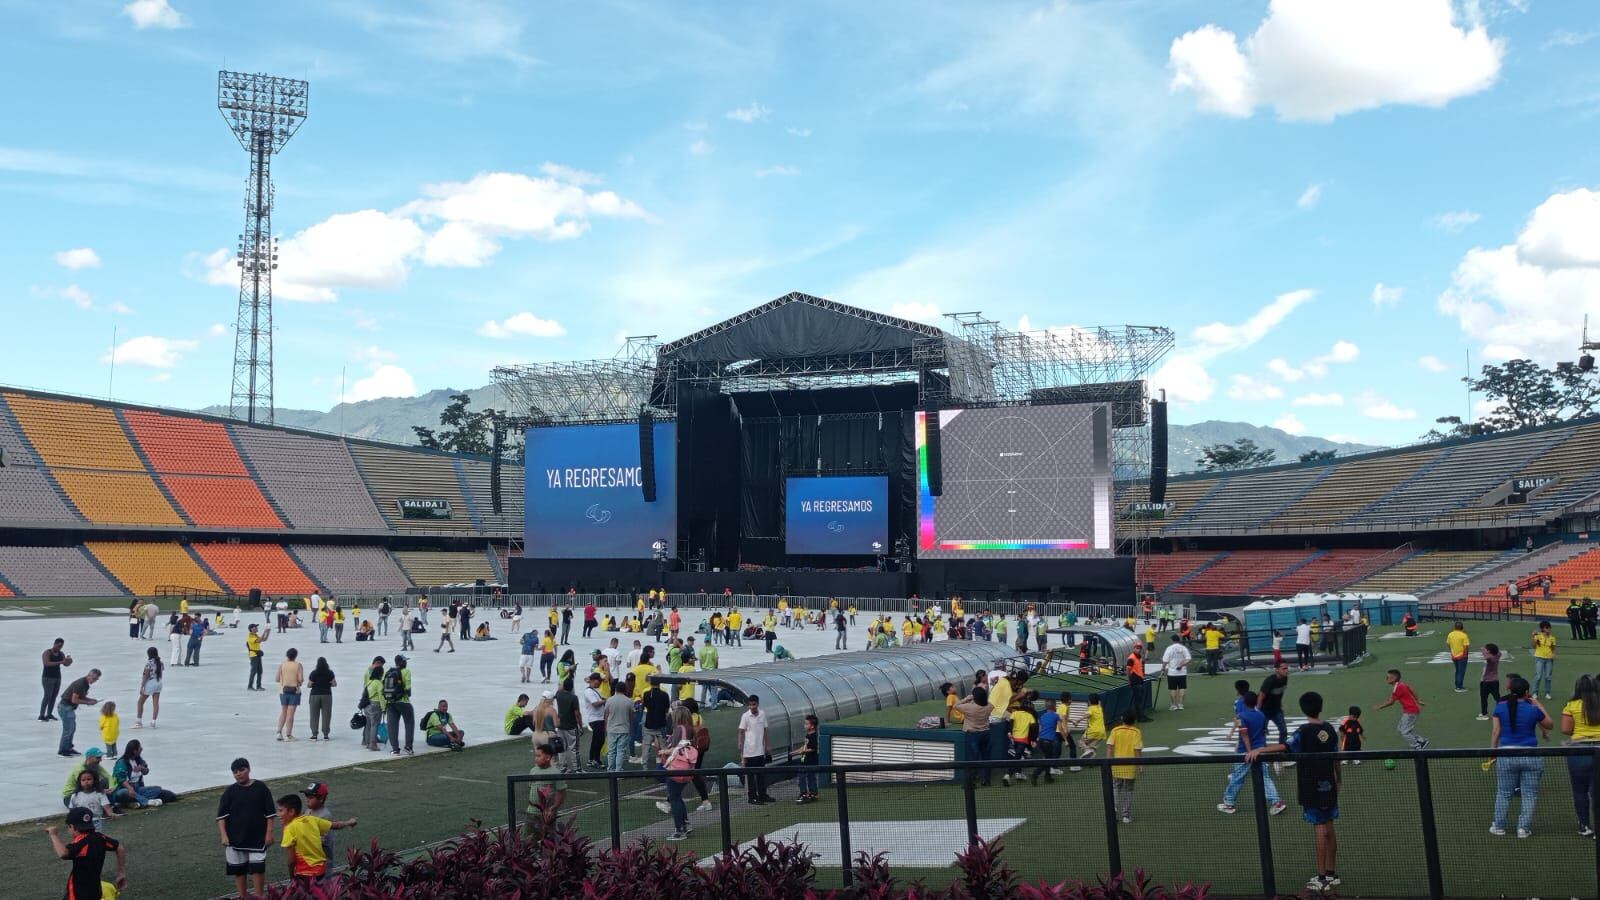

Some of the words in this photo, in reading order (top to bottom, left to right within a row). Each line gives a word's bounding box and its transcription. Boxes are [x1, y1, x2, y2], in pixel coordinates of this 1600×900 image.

[547, 469, 561, 488] YA
[565, 467, 642, 488] REGRESAMO
[404, 500, 438, 508] SALIDA
[801, 501, 811, 512] YA
[813, 500, 873, 512] REGRESAMOS
